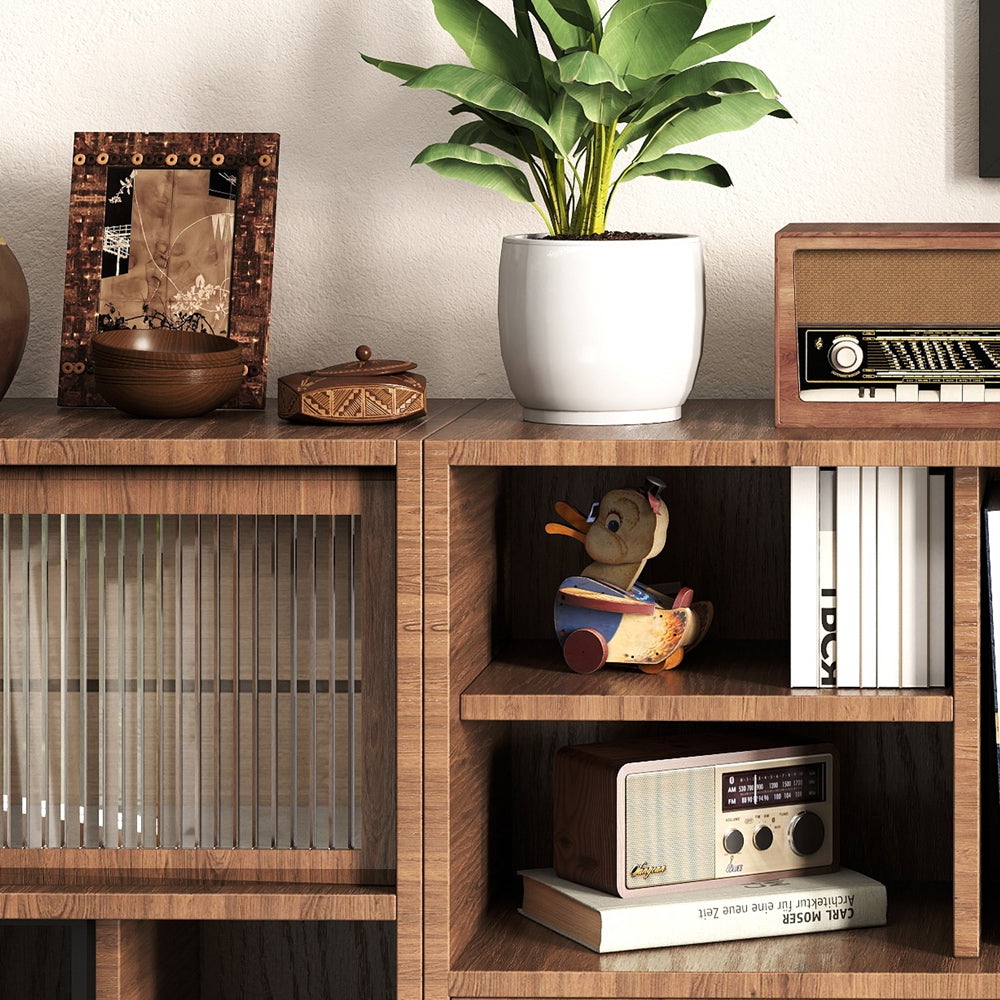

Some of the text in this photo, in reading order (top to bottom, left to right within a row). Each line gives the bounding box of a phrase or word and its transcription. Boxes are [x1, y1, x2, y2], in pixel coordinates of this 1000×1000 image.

[698, 894, 855, 920] Architektur für eine neue Zeit
[782, 908, 855, 925] CARL MOSER
